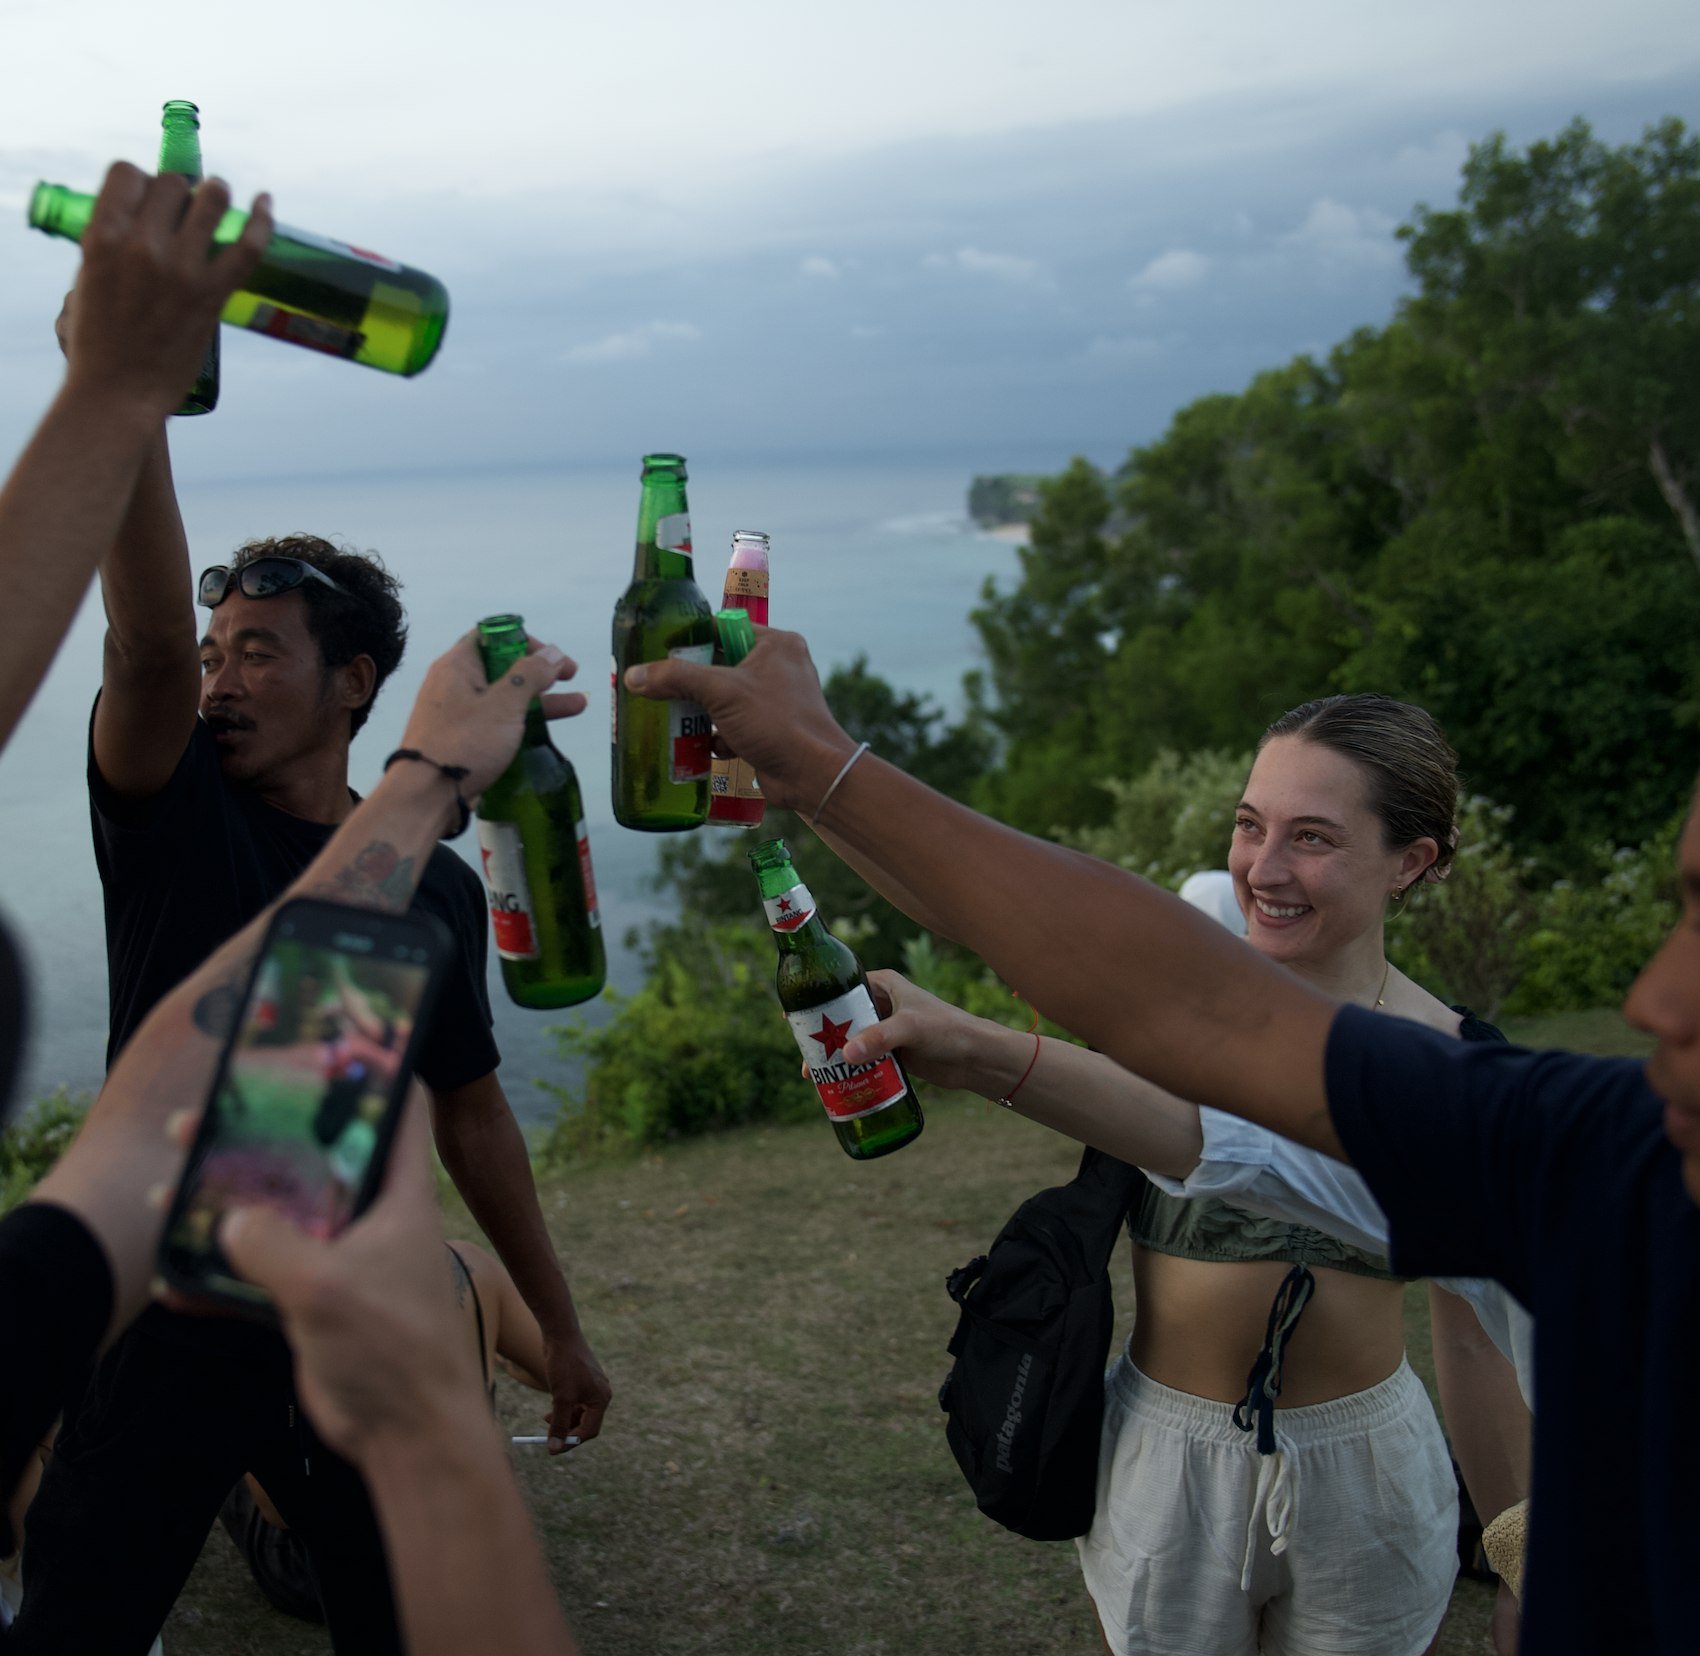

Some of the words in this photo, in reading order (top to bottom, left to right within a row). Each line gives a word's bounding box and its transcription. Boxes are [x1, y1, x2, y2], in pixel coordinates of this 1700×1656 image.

[490, 891, 520, 912] NG
[775, 908, 803, 923] BINTANG
[996, 1352, 1033, 1474] patagonia
